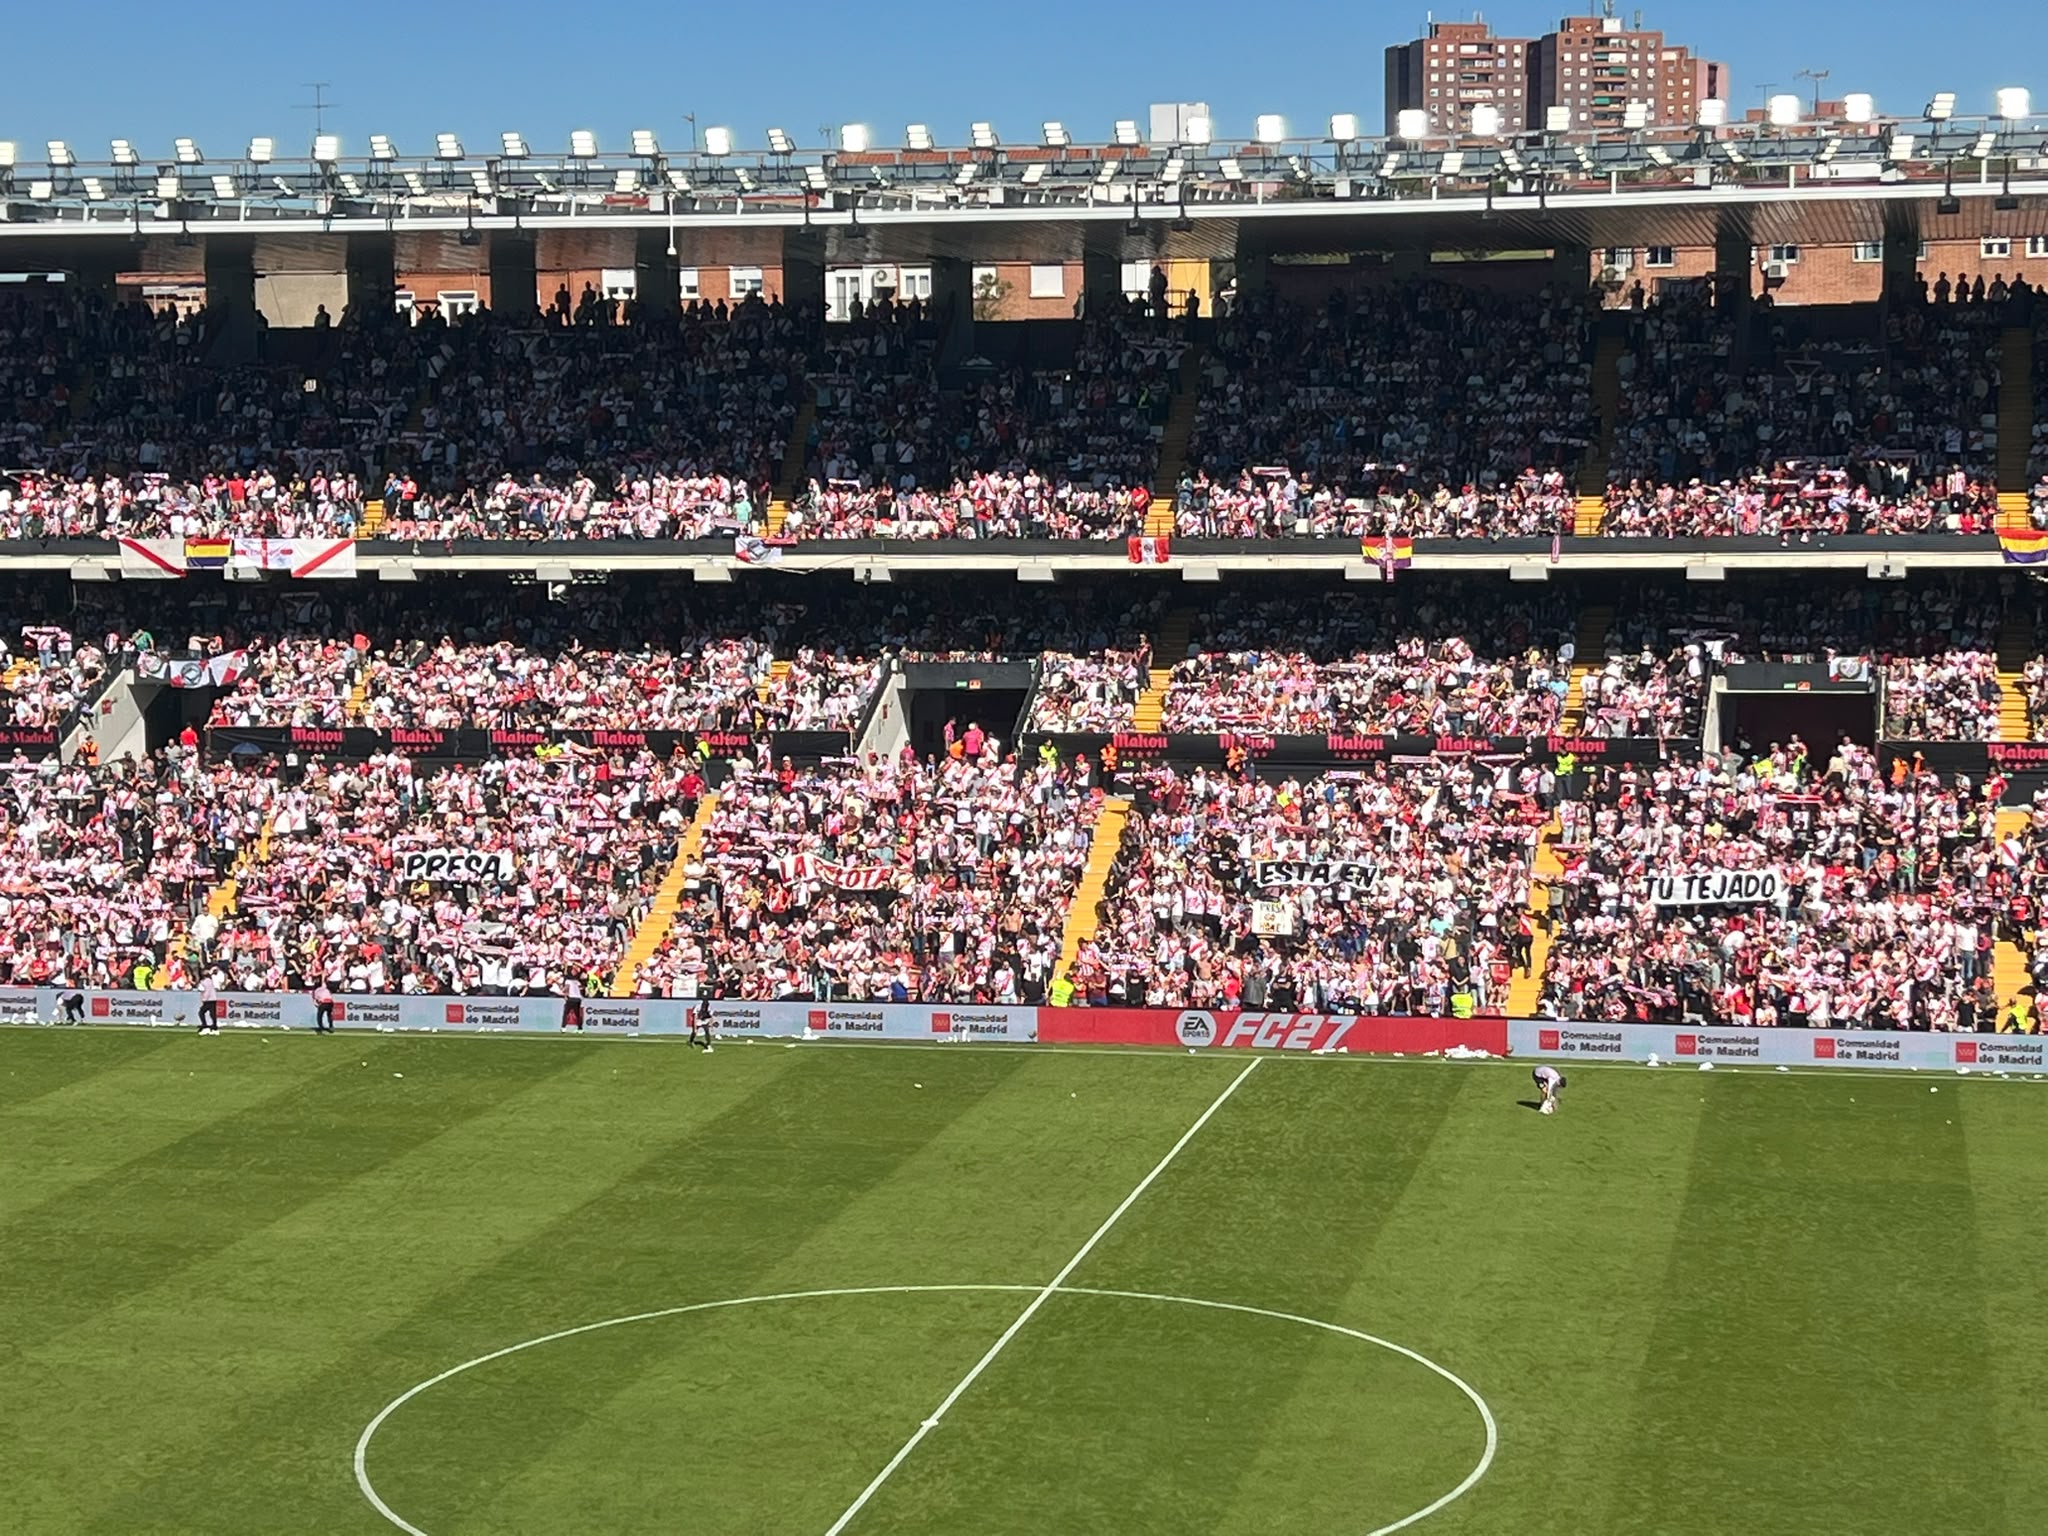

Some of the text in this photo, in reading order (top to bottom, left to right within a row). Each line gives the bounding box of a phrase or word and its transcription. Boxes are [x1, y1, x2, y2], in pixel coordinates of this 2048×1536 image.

[291, 728, 343, 743] Mahou
[391, 728, 444, 743] Mahu
[593, 730, 646, 745] Mahou
[1113, 734, 1168, 748] Mahou
[1219, 734, 1275, 749] Mhou
[1327, 735, 1384, 750] Mahou
[1548, 737, 1606, 753] Mahou
[779, 856, 807, 884] LA
[1260, 862, 1378, 888] ESTA EN
[1643, 873, 1776, 900] TU TEJADO
[111, 998, 163, 1006] Comunidad
[228, 1000, 281, 1009] Comunidad
[347, 1002, 400, 1011] Comunidad
[111, 1009, 163, 1018] de Madrid
[466, 1004, 519, 1013] Comunidad
[586, 1007, 639, 1016] Comunidad
[228, 1010, 281, 1020] de Madrid
[347, 1012, 400, 1022] de Madrid
[466, 1014, 519, 1024] de Madrid
[828, 1011, 883, 1020] Comunidad
[952, 1013, 1008, 1022] Comunidad
[586, 1017, 639, 1027] de Madrid
[722, 1020, 760, 1029] Madrid
[828, 1021, 883, 1031] de Madrid
[1183, 1017, 1209, 1030] EA
[952, 1024, 1008, 1034] de Madrid
[1222, 1013, 1358, 1049] FC27
[1561, 1031, 1622, 1041] Comunidad
[1698, 1035, 1759, 1045] Comunidad
[1561, 1042, 1622, 1053] de Madrid
[1836, 1038, 1900, 1049] Comunidad
[1979, 1042, 2043, 1053] Comunidad
[1698, 1046, 1759, 1057] de Madrid
[1836, 1050, 1900, 1061] de Madrid
[1979, 1054, 2043, 1066] de Madrid
